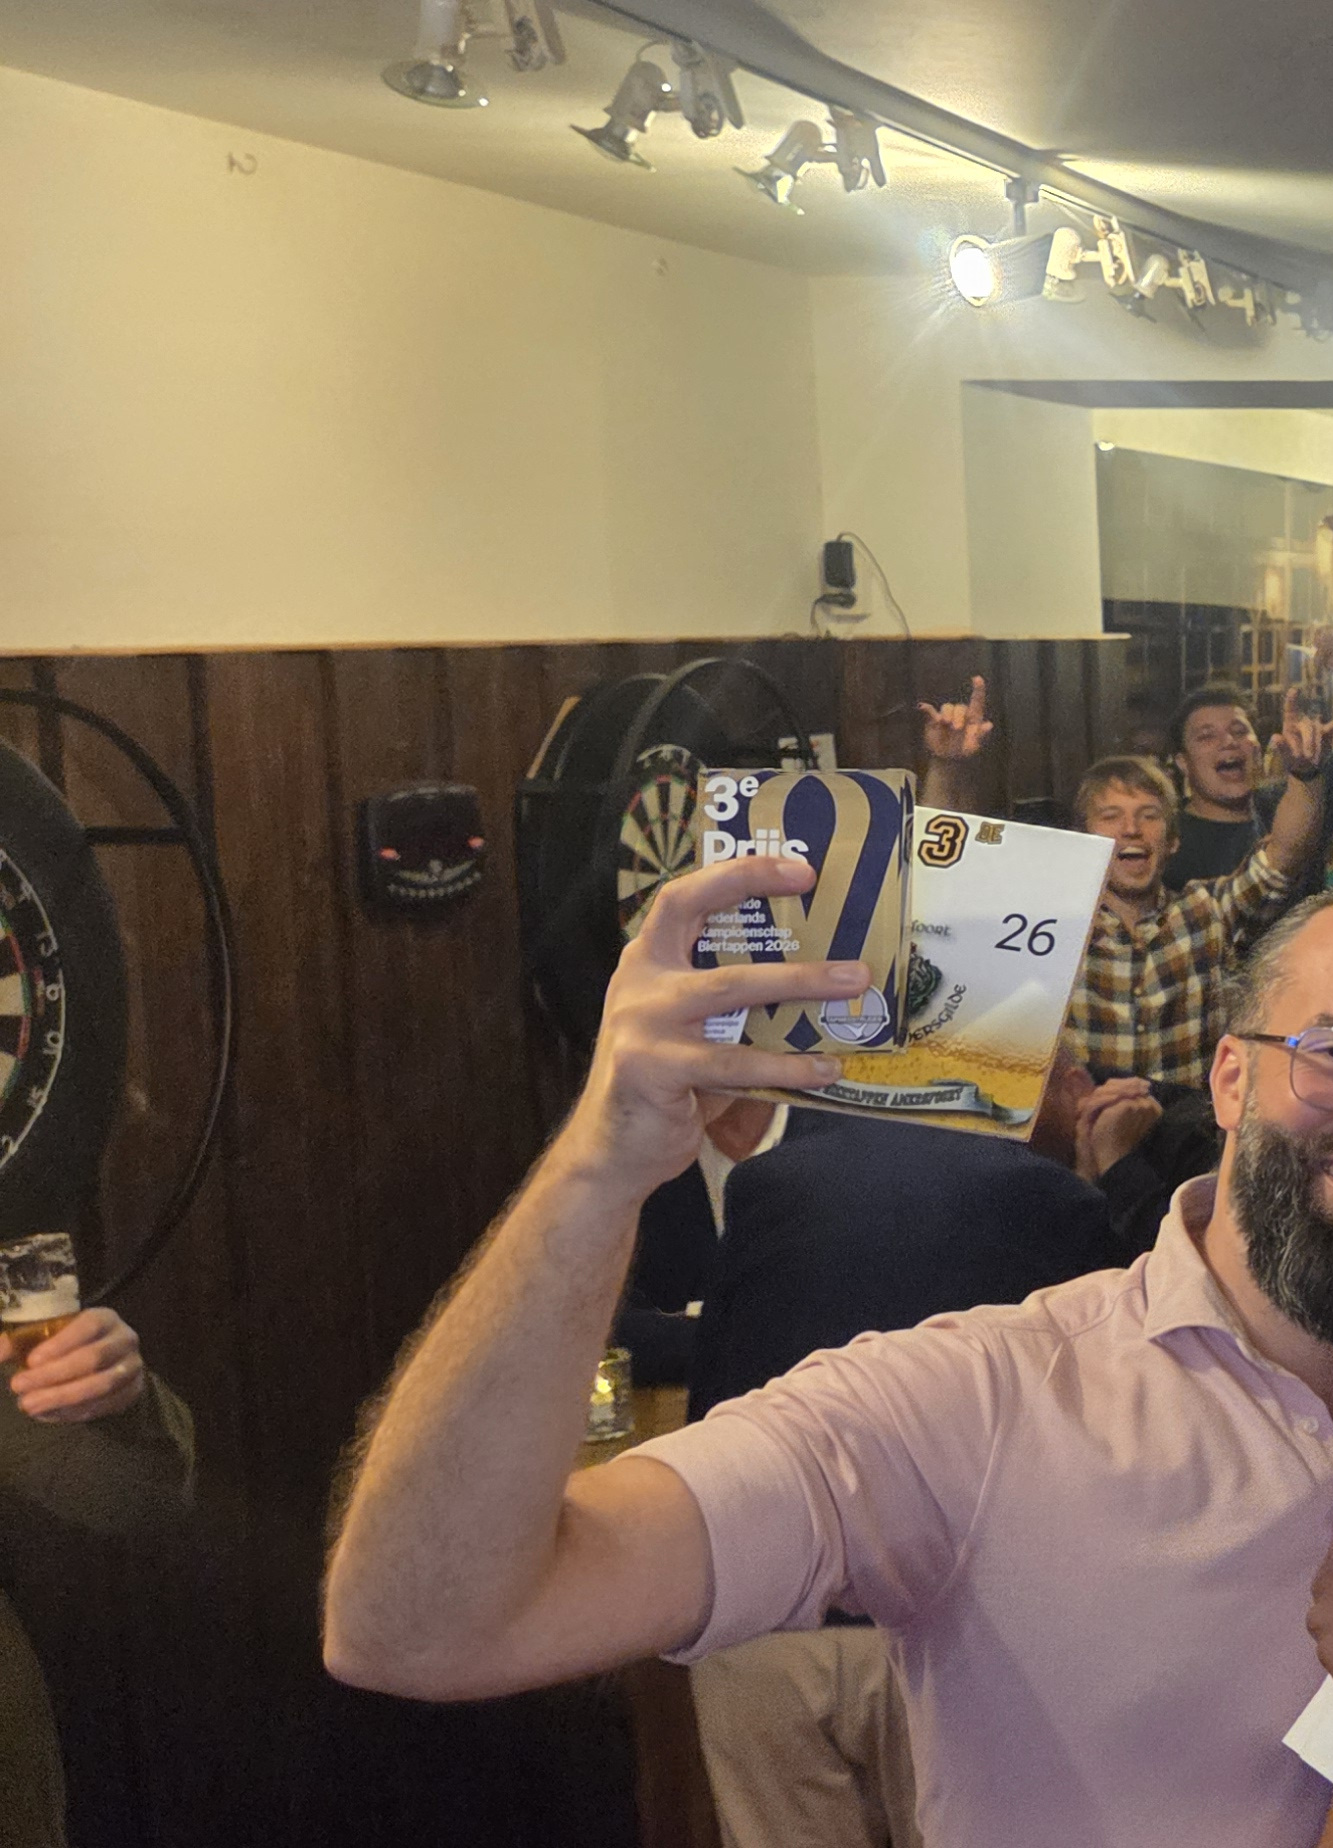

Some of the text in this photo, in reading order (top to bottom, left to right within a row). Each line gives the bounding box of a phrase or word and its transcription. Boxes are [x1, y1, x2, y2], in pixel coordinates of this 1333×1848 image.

[918, 814, 969, 868] 3
[707, 911, 766, 924] ederlands
[700, 926, 792, 940] ampioenschap
[994, 913, 1057, 957] 26
[698, 940, 800, 954] Biertappen 2026
